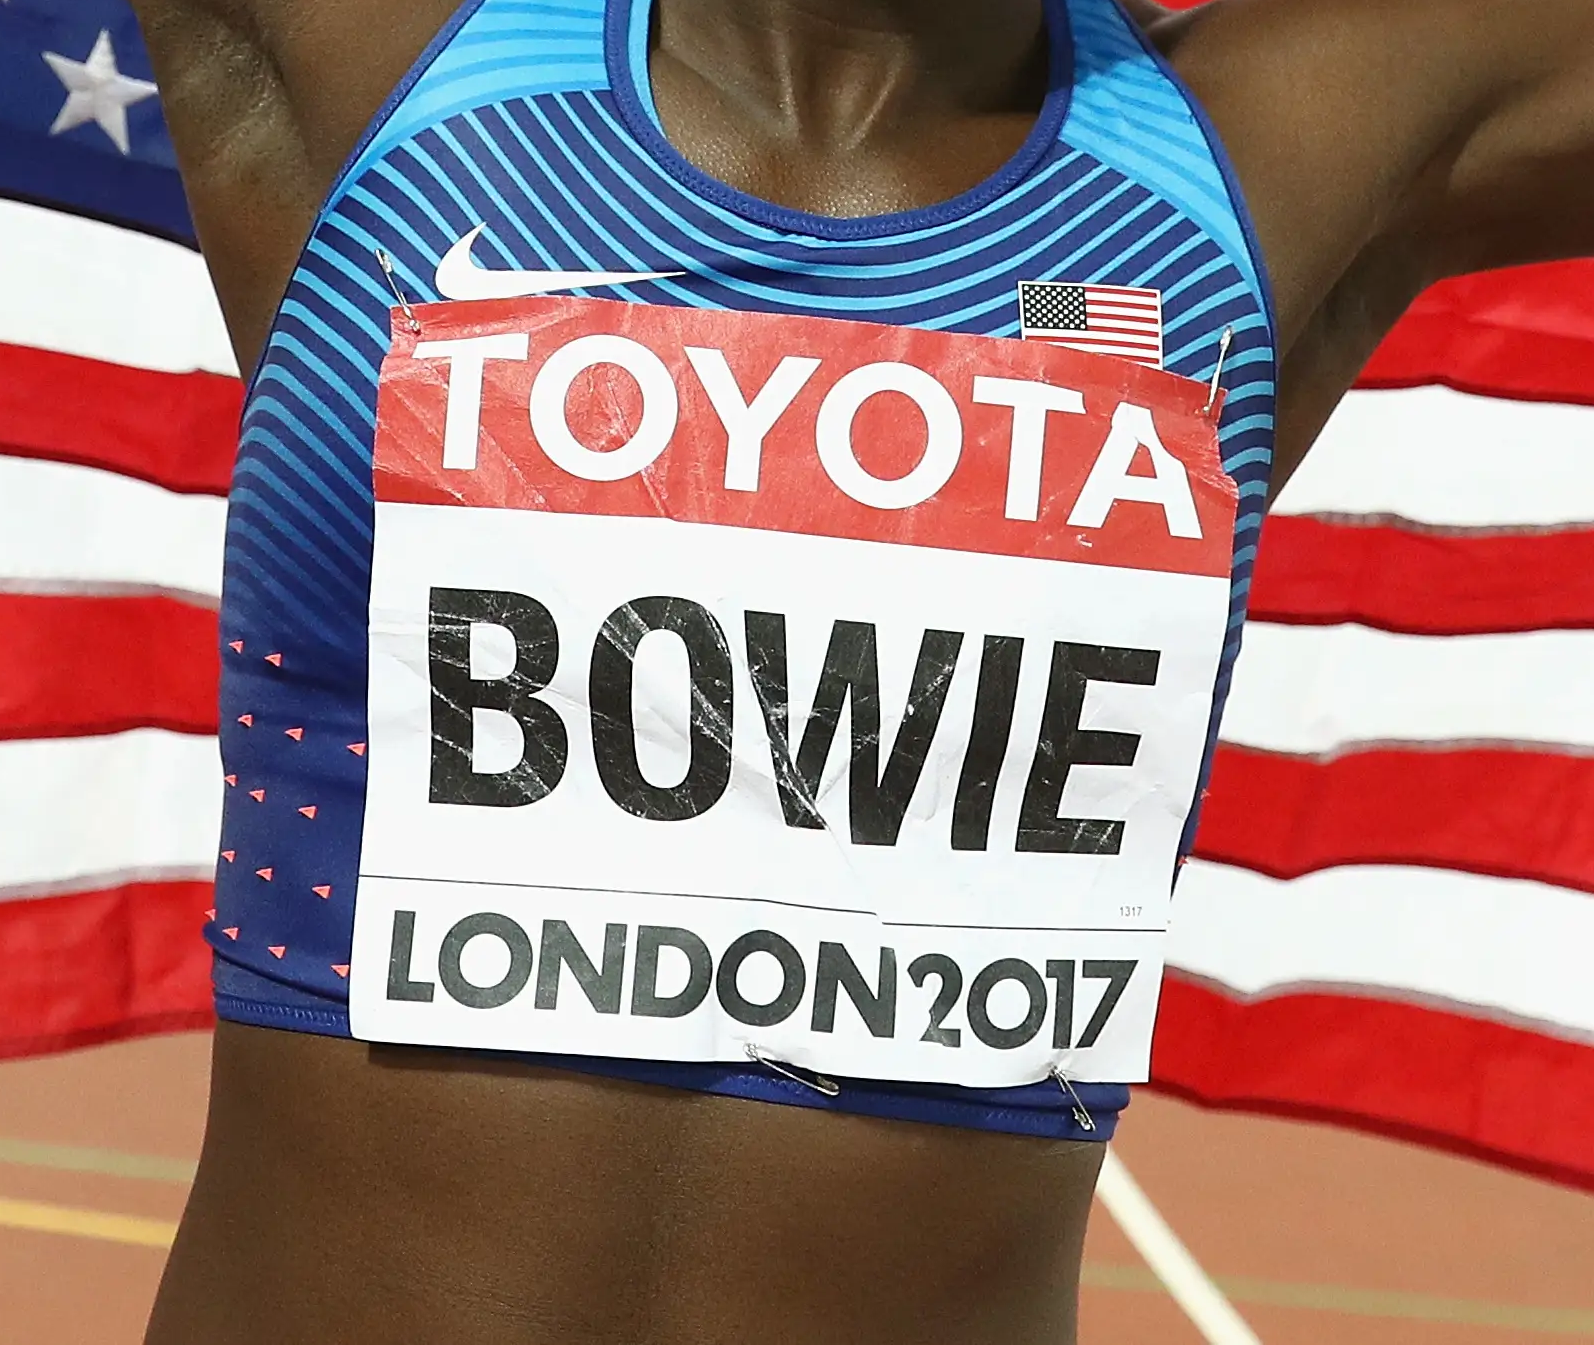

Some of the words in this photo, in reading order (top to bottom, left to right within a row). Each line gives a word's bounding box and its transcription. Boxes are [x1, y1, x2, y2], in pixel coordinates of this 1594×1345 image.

[413, 331, 1204, 539] TOYOTA
[427, 585, 1161, 854] BOWIE
[1119, 905, 1143, 917] 1317
